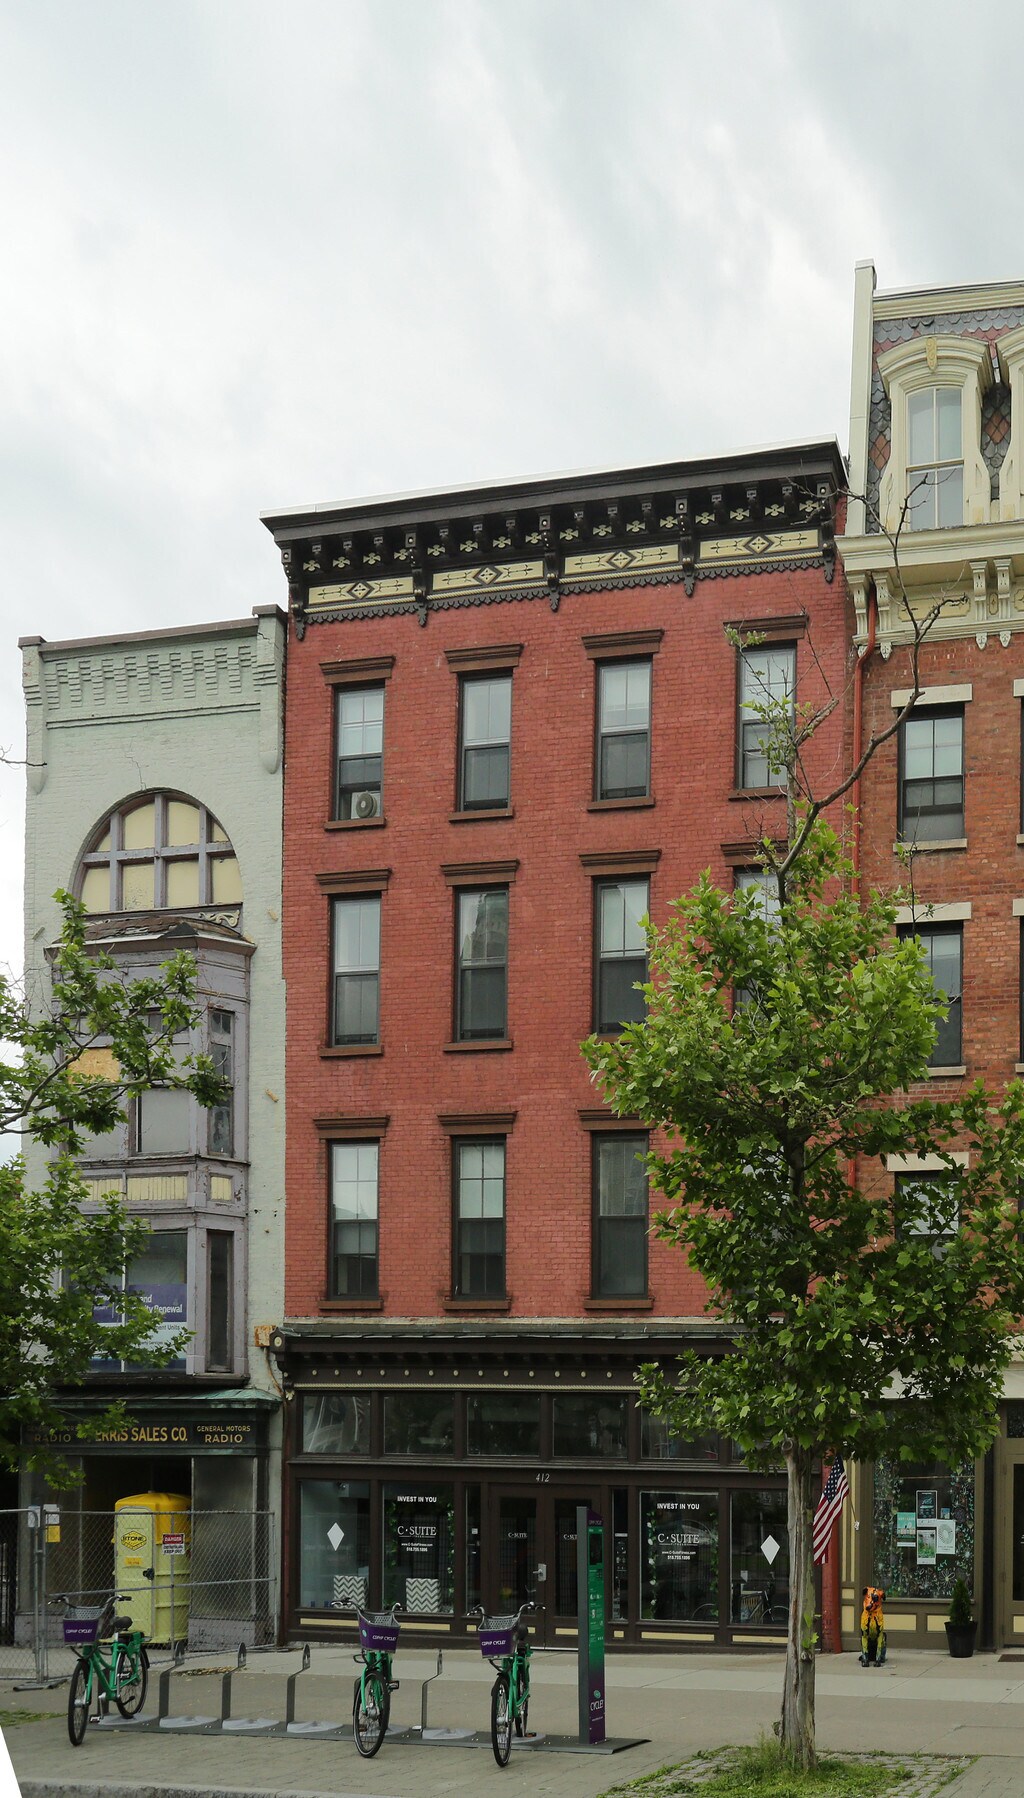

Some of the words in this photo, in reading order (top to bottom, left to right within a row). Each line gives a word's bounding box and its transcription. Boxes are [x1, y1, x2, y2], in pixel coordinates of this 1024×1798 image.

[131, 1427, 167, 1441] SALES
[171, 1427, 187, 1441] CO.
[205, 1434, 242, 1443] RADIO
[536, 1474, 550, 1482] 412
